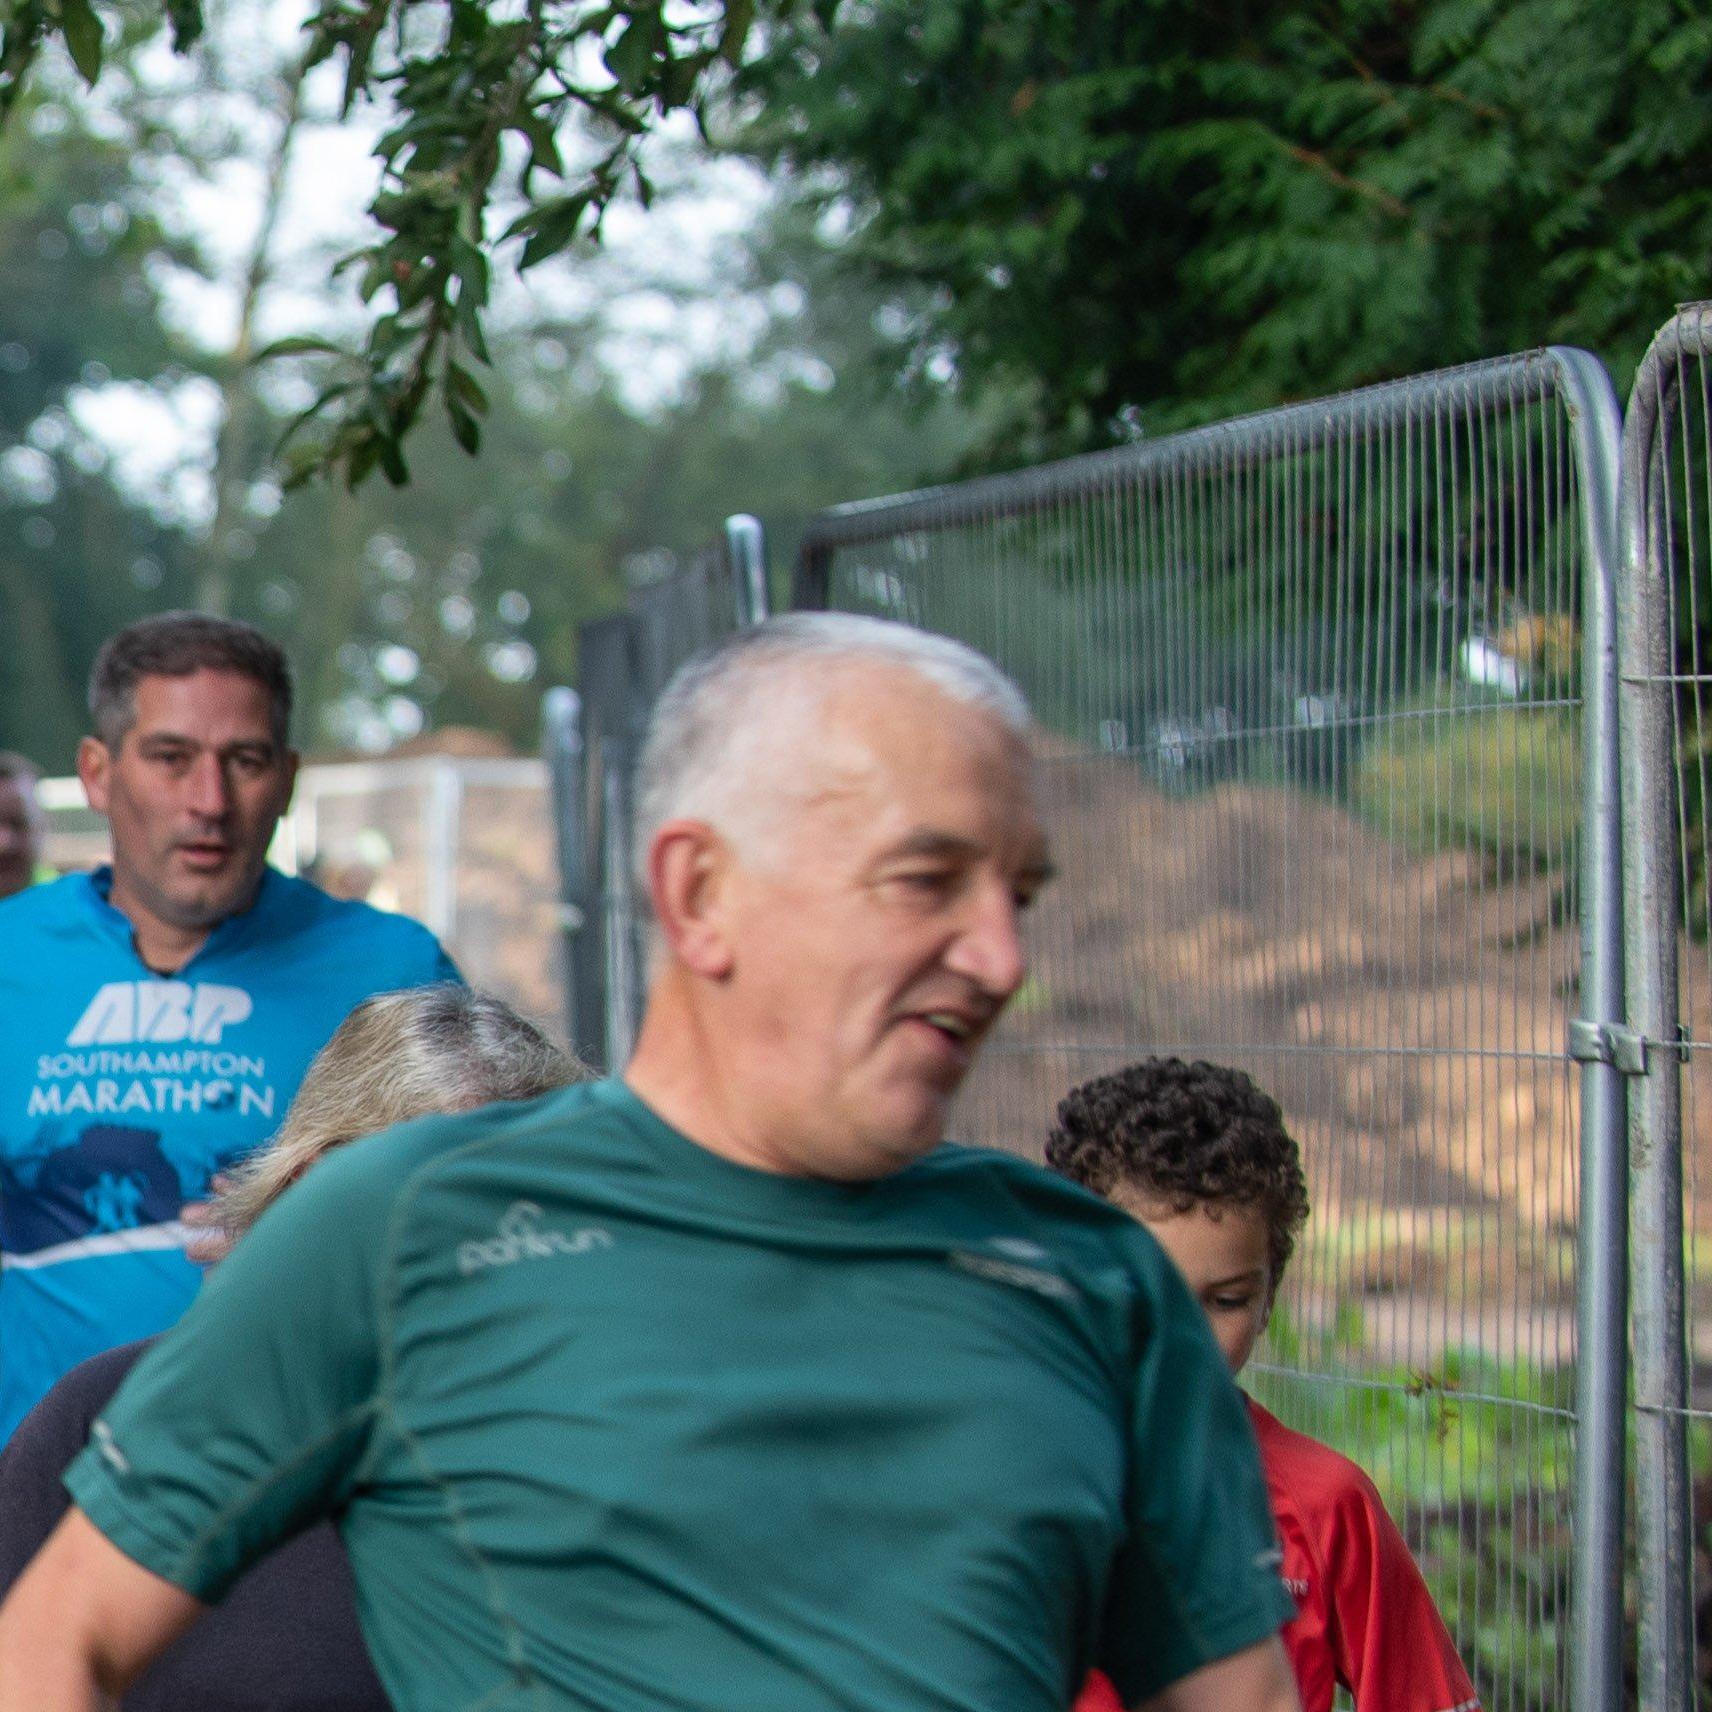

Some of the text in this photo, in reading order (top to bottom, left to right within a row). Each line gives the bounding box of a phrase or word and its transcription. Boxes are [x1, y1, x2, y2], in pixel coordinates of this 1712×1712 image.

[65, 979, 254, 1047] ABP
[36, 1050, 266, 1080] SOUTHAMPTON
[26, 1078, 275, 1119] MARATHON
